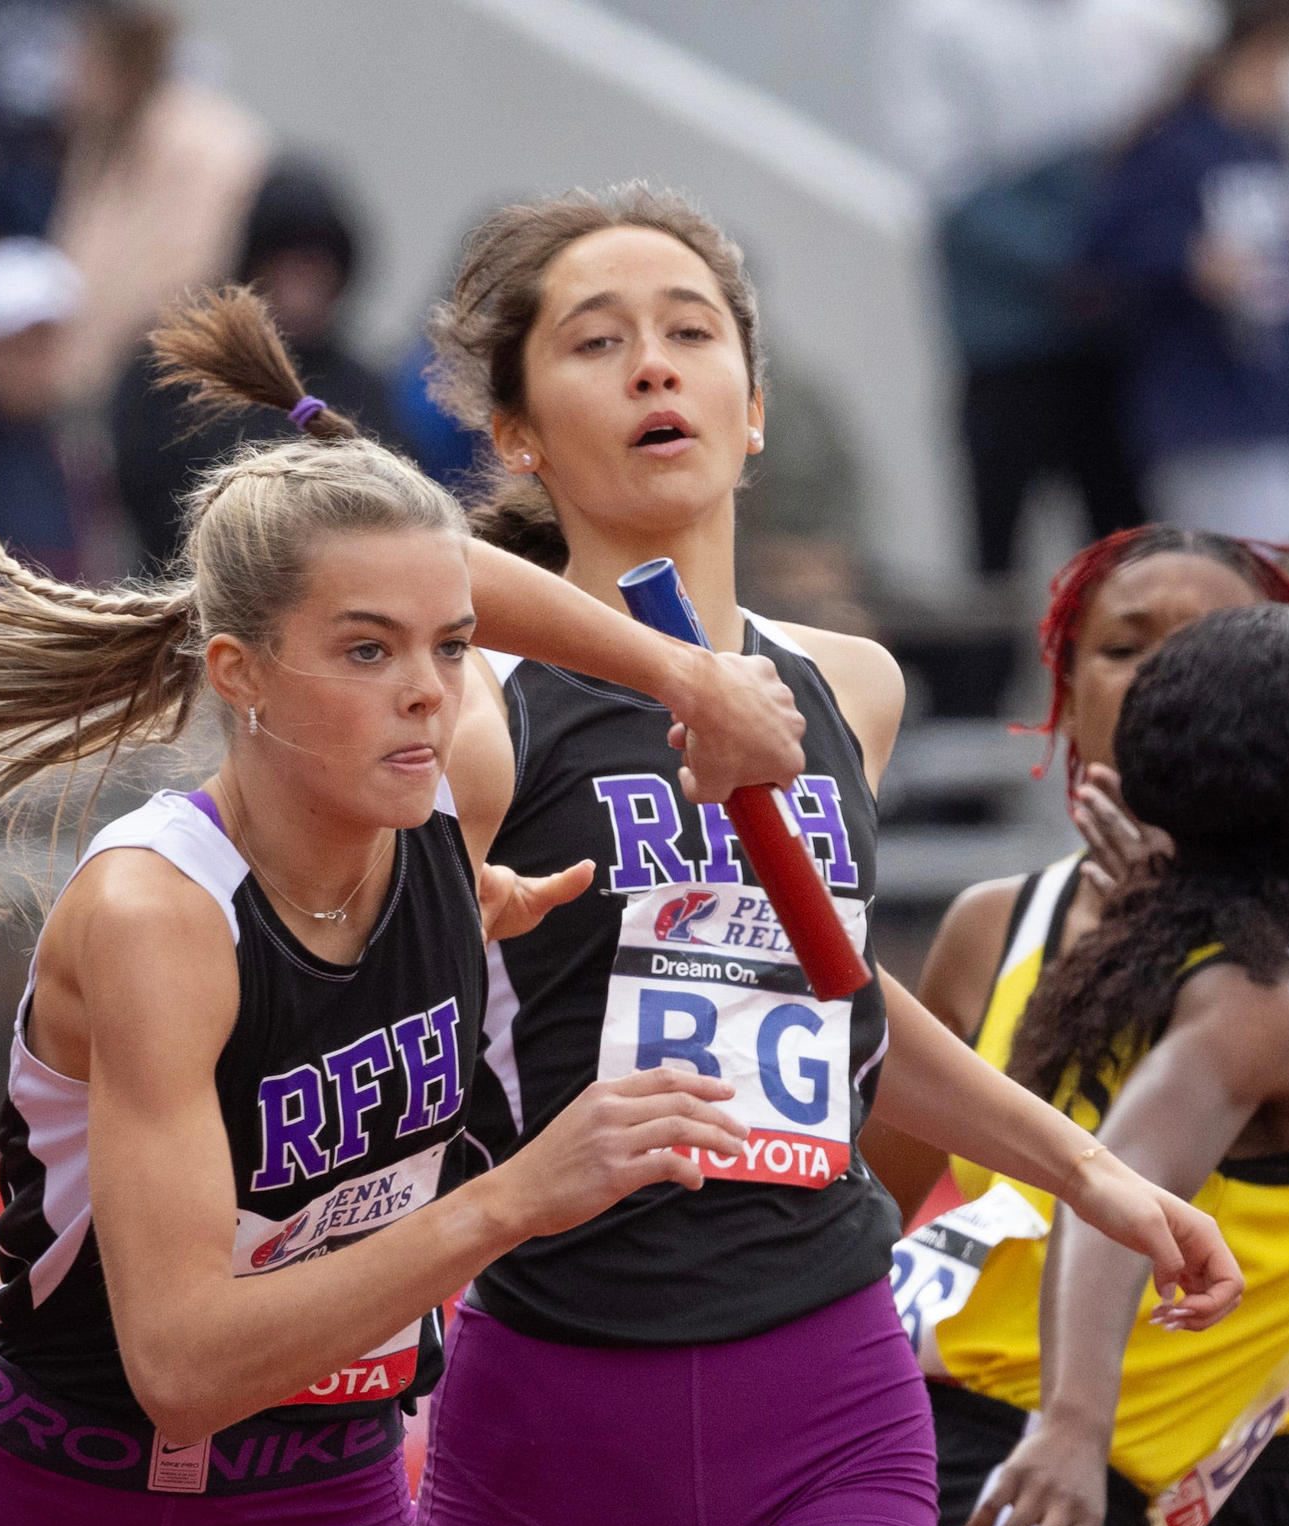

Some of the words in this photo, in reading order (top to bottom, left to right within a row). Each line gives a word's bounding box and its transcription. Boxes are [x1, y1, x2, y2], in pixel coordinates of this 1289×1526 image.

[731, 897, 778, 924] PE
[652, 955, 721, 979] Dream
[725, 962, 759, 984] On.
[251, 996, 464, 1192] RFH
[309, 1183, 414, 1242] RELAYS
[319, 1171, 398, 1220] PENN
[209, 1418, 388, 1482] NIKE
